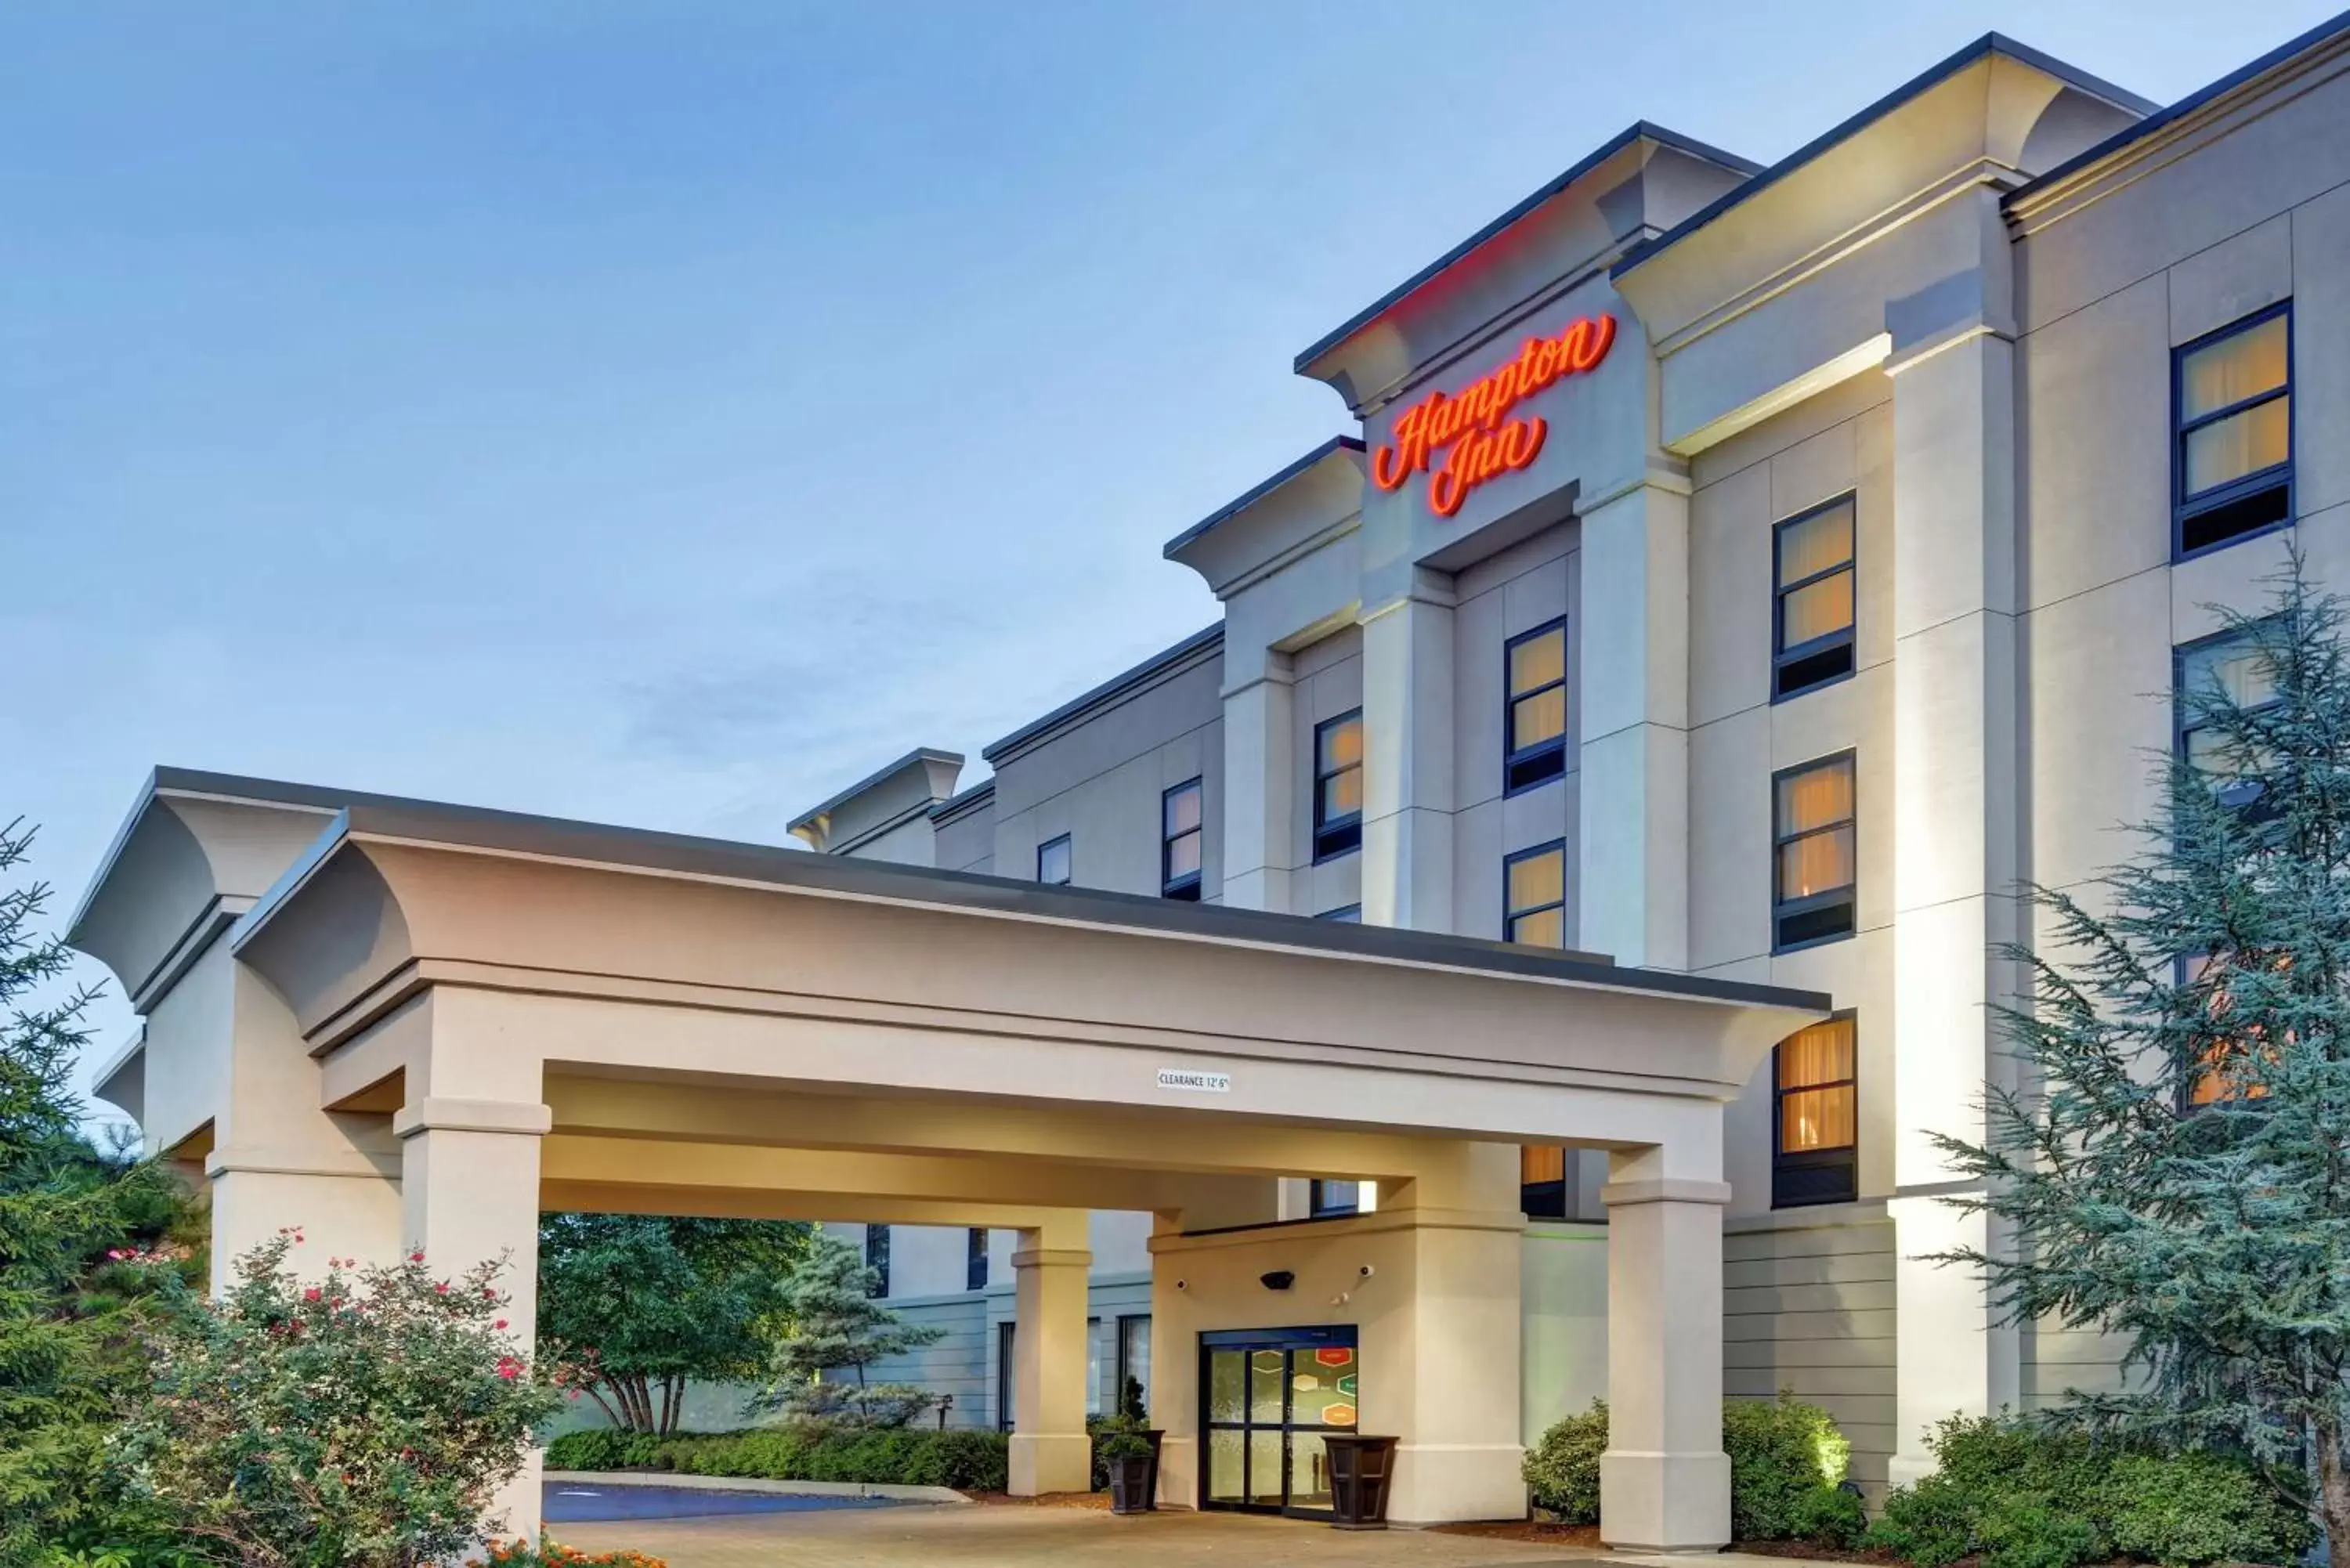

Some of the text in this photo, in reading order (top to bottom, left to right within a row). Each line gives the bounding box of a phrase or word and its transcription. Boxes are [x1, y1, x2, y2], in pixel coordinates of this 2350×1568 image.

[1376, 314, 1616, 490] Hampton
[1430, 417, 1547, 517] Inn
[1159, 1073, 1204, 1086] CLEARANCE
